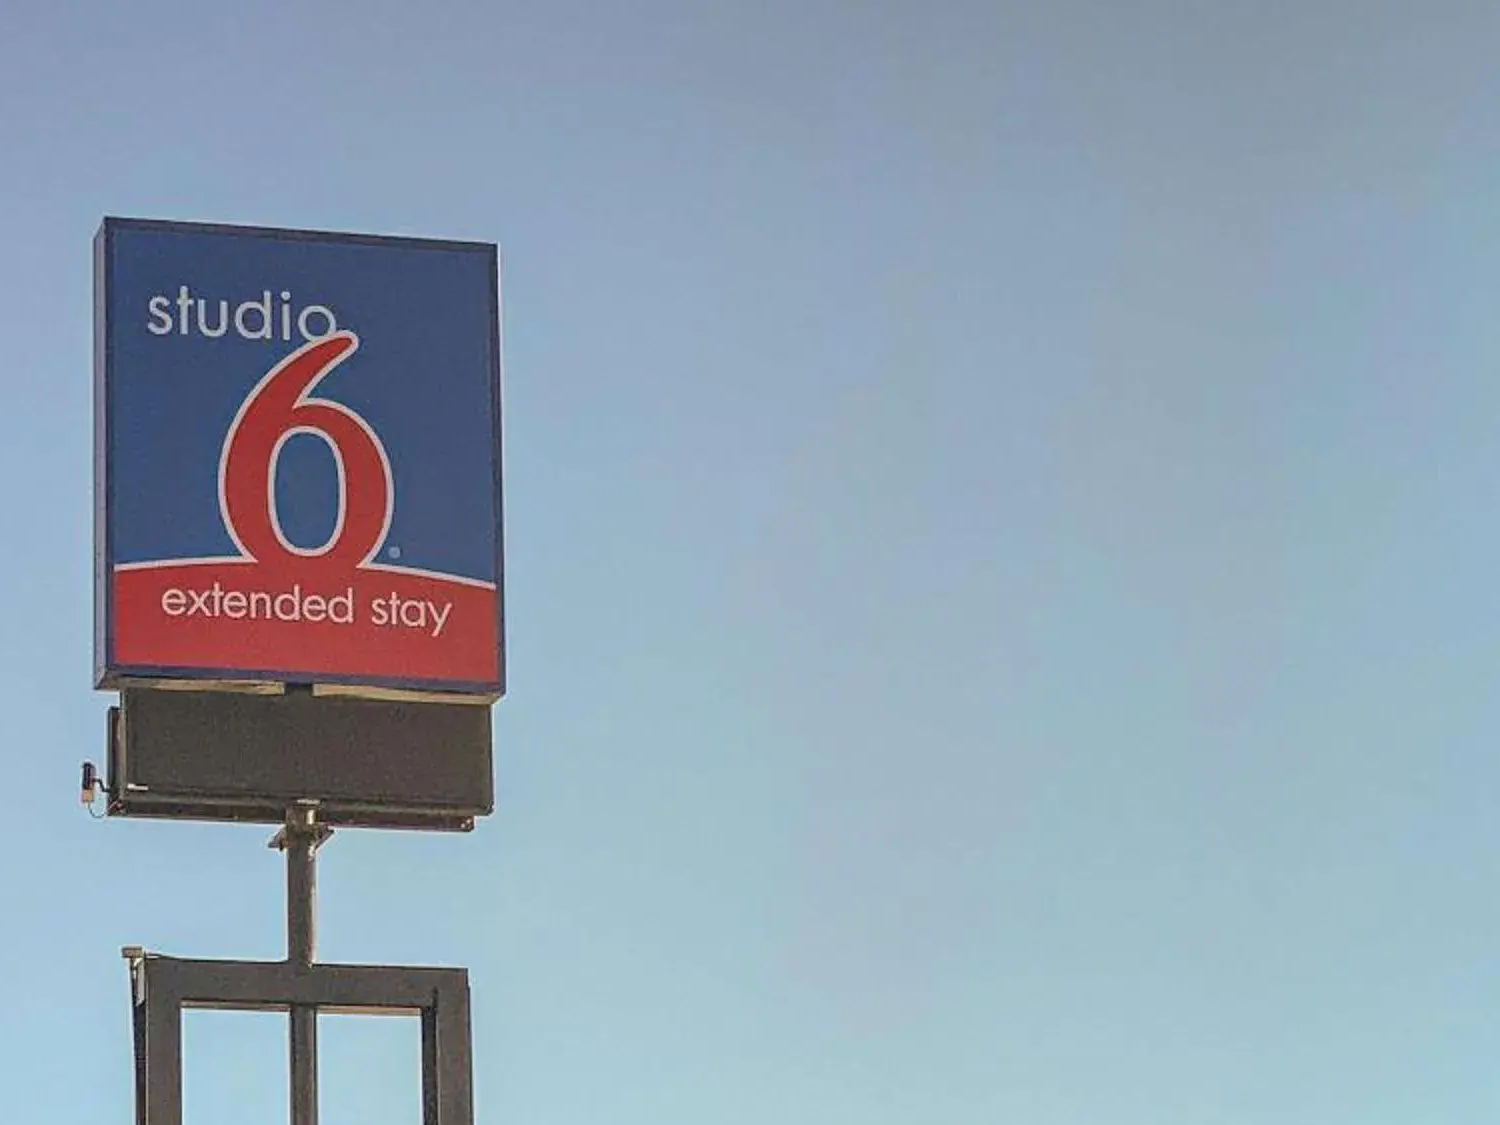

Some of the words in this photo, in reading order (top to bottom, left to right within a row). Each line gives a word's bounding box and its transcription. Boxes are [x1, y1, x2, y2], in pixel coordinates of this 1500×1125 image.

[147, 285, 336, 342] studio
[217, 329, 395, 568] 6
[161, 584, 354, 626] extended
[370, 595, 453, 637] stay
